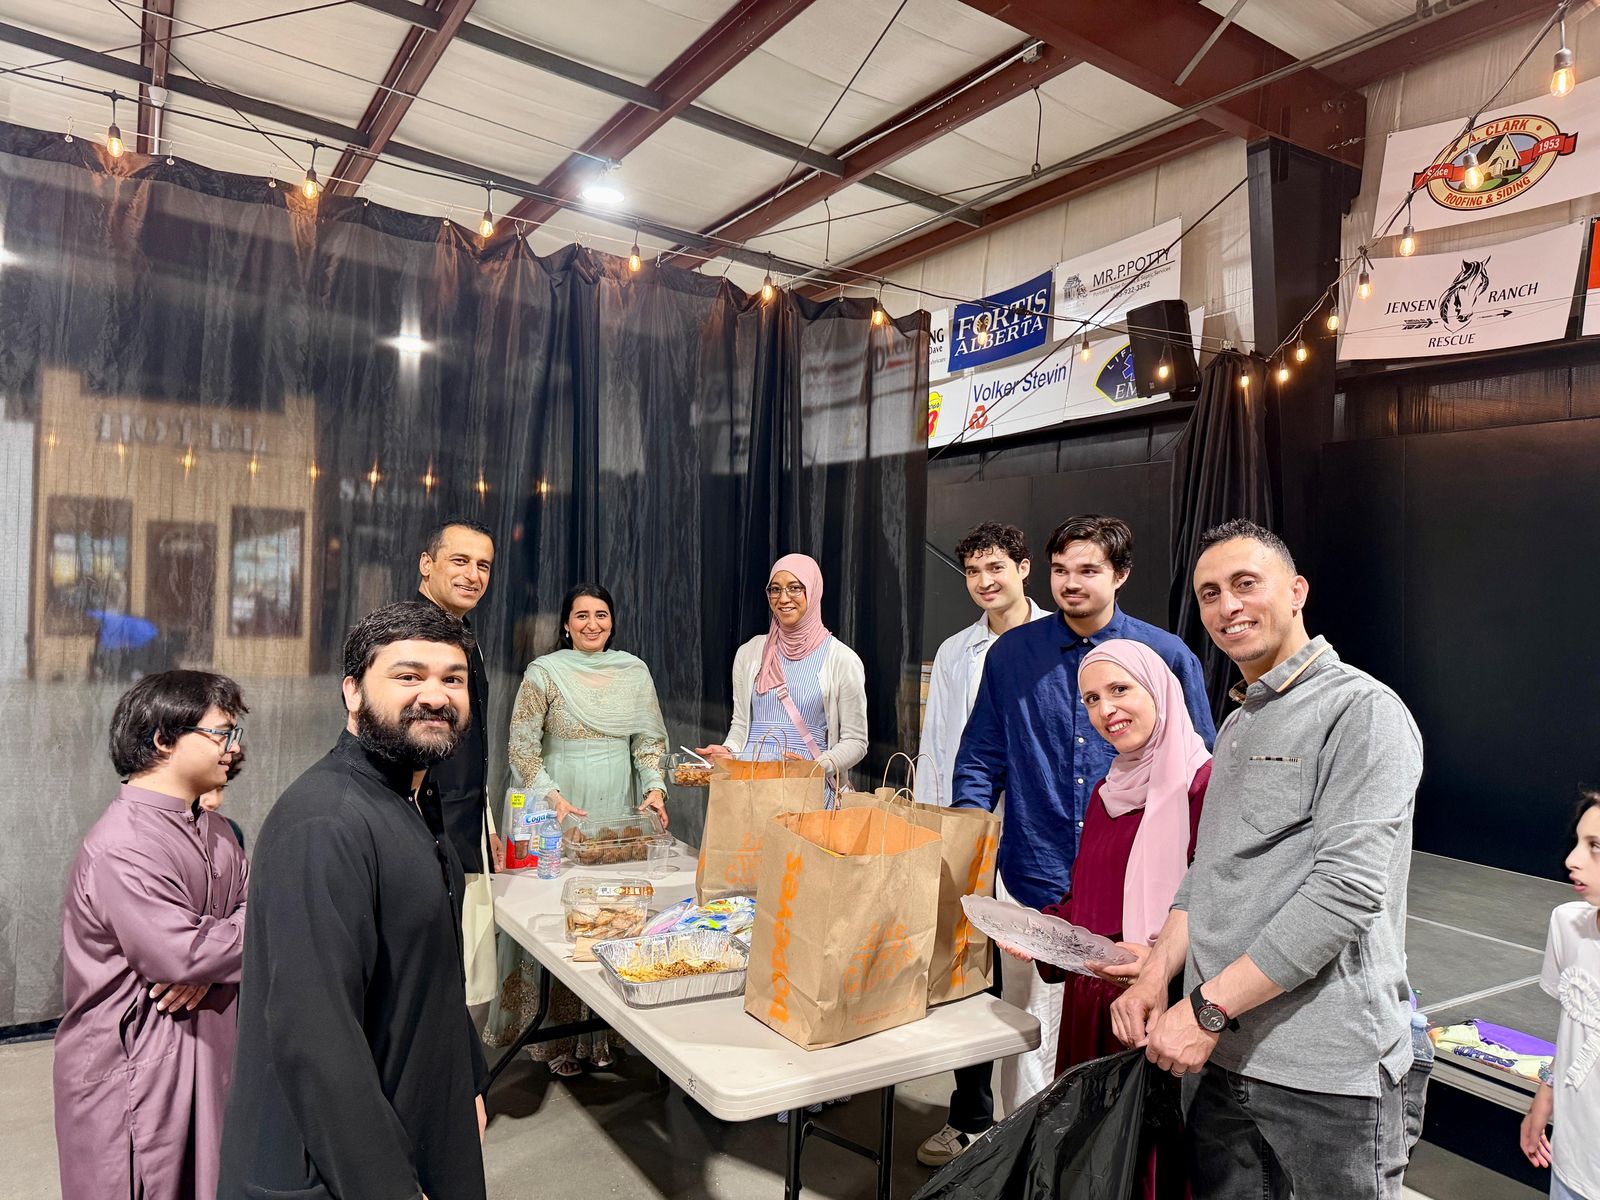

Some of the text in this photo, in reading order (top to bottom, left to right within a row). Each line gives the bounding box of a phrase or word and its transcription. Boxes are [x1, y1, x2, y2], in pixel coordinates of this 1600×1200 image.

[1485, 119, 1529, 135] CLARK
[1539, 138, 1560, 153] 1953
[1444, 176, 1531, 207] ROOFING & SIDING
[1384, 282, 1539, 315] JENSEN RANCH
[956, 288, 1047, 341] FORTIS
[954, 316, 1044, 357] ALBERTA
[1428, 333, 1476, 348] RESCUE
[1107, 346, 1132, 370] LIF
[973, 364, 1067, 403] Volker Stevin
